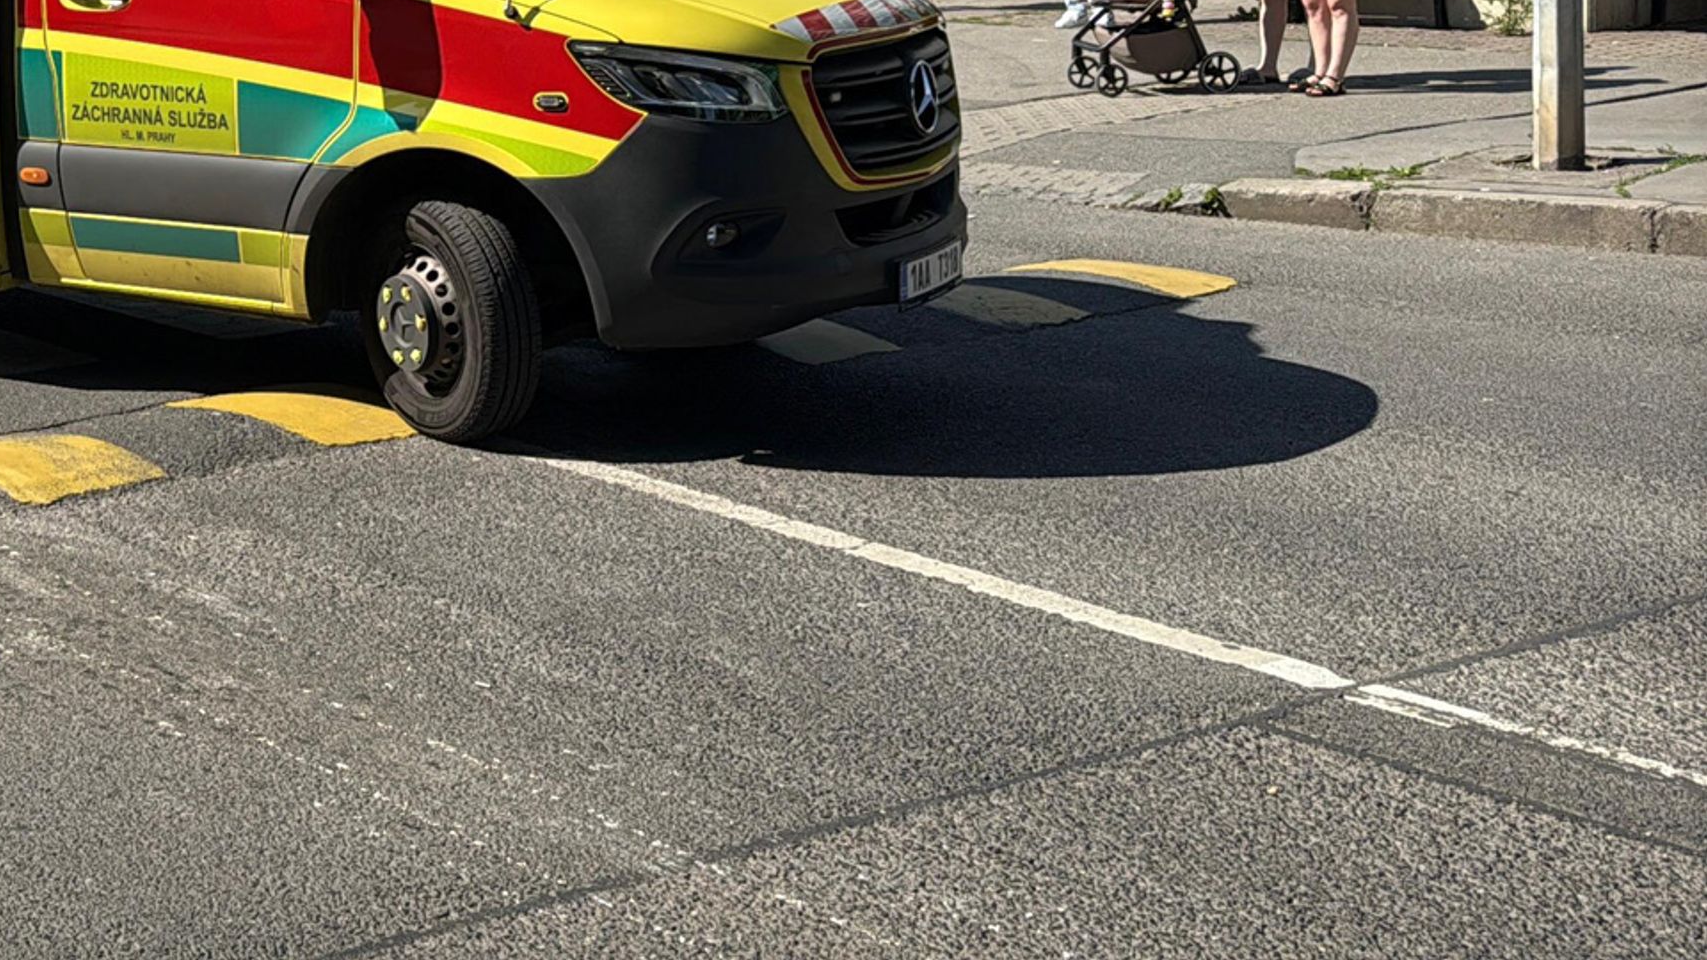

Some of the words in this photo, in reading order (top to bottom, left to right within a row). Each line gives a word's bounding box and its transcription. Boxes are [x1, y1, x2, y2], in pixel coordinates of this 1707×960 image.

[90, 81, 207, 104] ZDRAVOTNICKÁ
[72, 100, 164, 126] ZÁCHRANNÁ
[167, 106, 229, 130] SLUŽBA
[147, 131, 176, 143] PRAHY
[911, 259, 932, 294] 1AA
